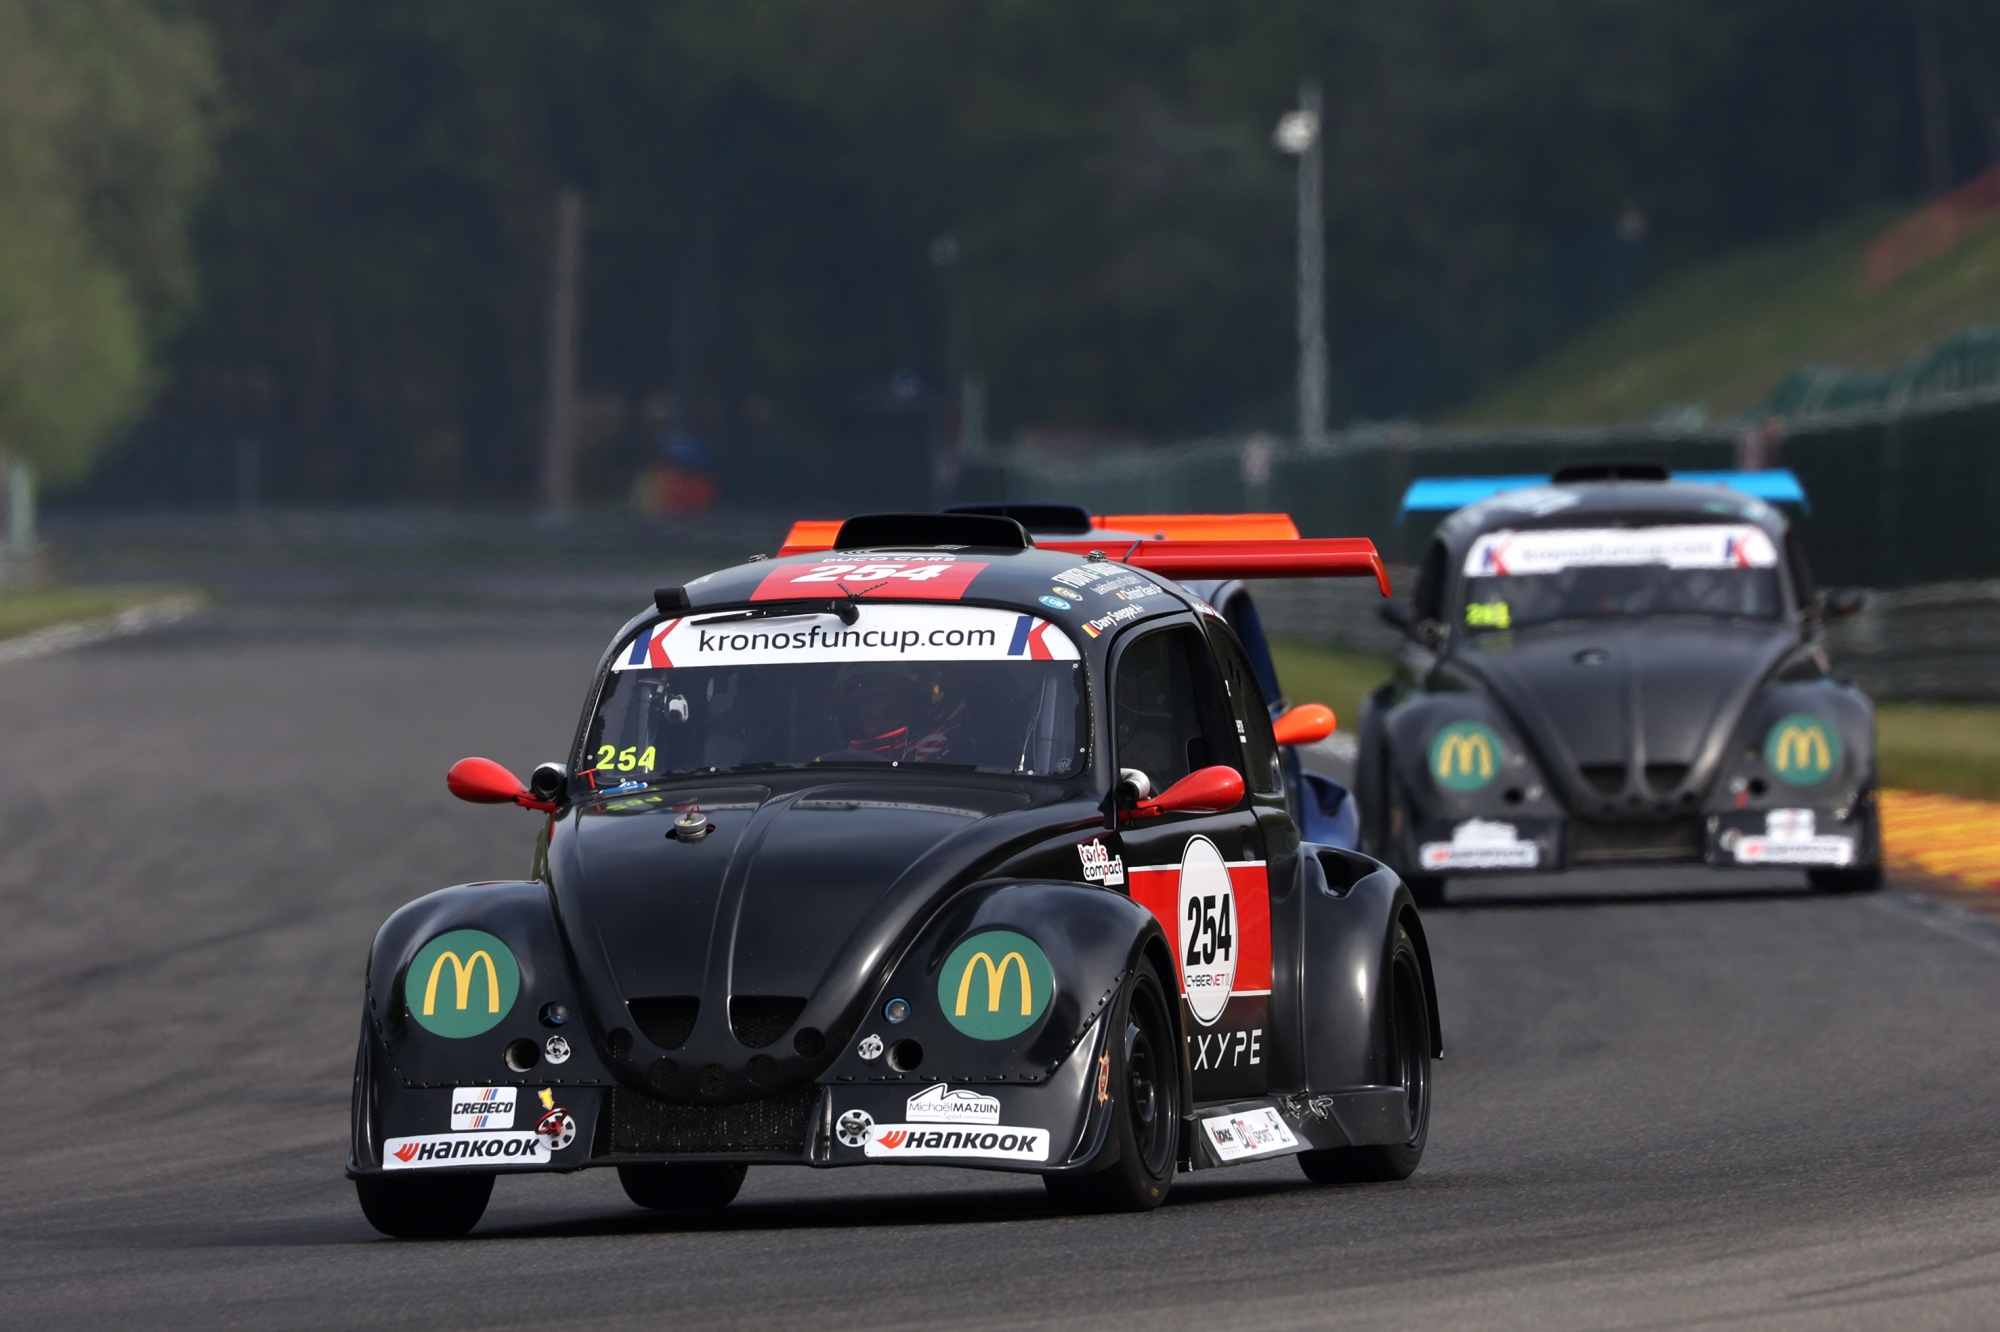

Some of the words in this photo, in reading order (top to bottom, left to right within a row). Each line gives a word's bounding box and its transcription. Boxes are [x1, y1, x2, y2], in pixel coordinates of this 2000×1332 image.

[790, 564, 953, 583] 254
[1090, 611, 1117, 632] Davy
[698, 624, 996, 653] kronosfuncup.com
[596, 744, 657, 772] 254
[1085, 856, 1123, 884] compact
[1186, 893, 1232, 967] 254
[1187, 1028, 1263, 1071] XYPE
[453, 1101, 514, 1115] CREDECO
[942, 1112, 963, 1121] Sport
